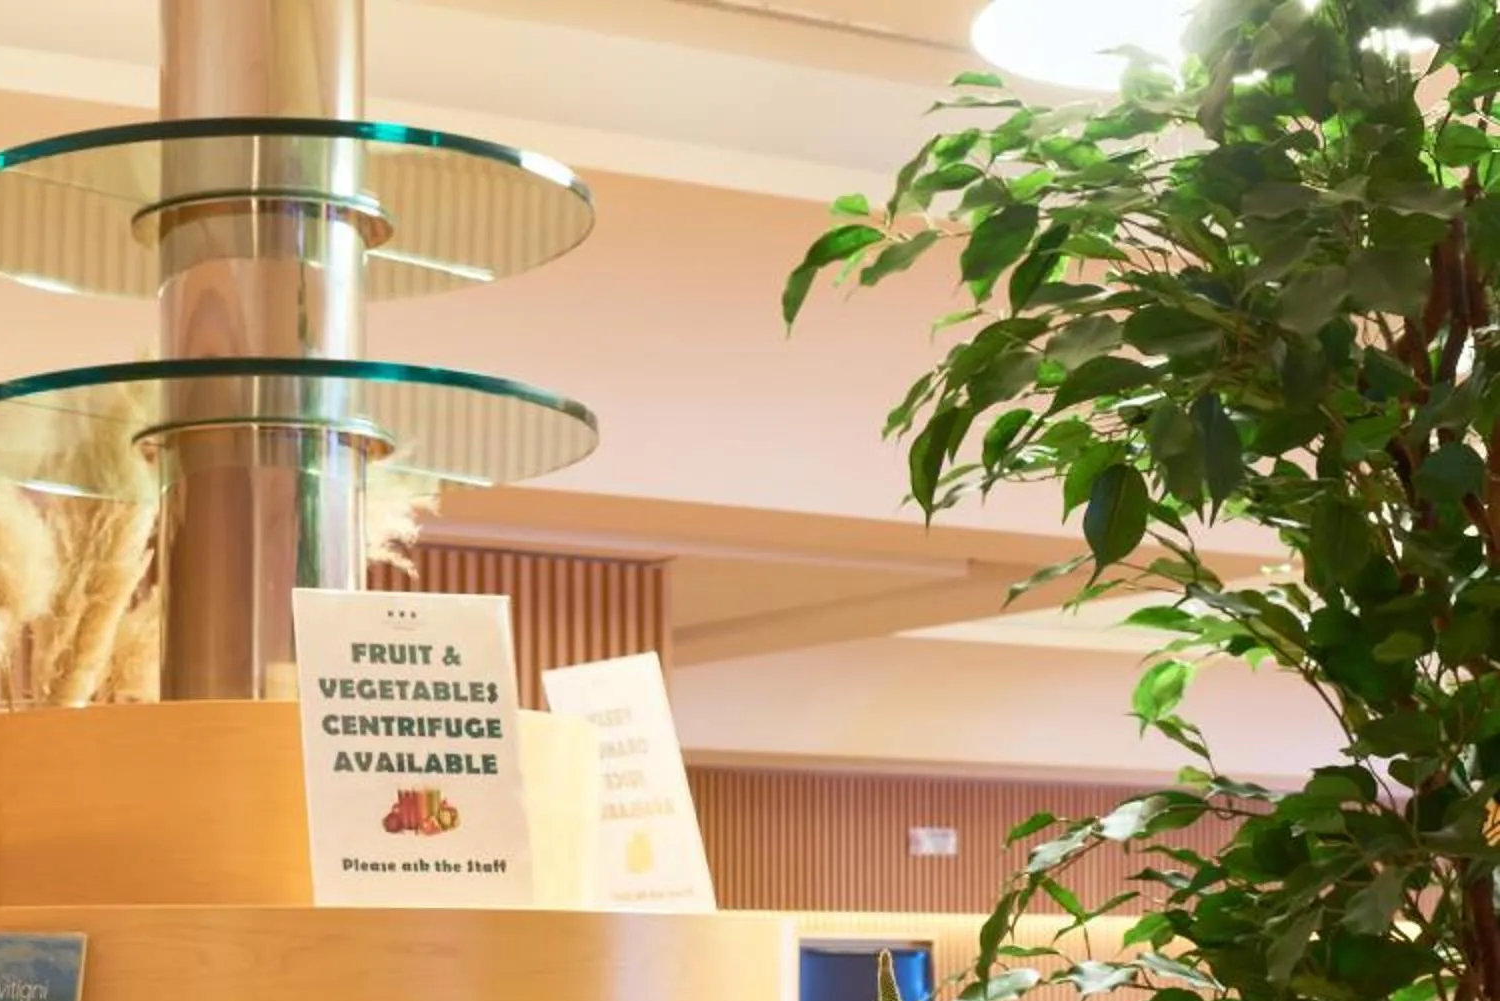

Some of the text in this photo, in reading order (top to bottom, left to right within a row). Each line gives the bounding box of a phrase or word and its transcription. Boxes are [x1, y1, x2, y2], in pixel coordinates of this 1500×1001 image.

[351, 643, 461, 666] FRUIT &
[318, 678, 499, 704] VEGETABLES
[321, 714, 503, 739] CENTRIFUGE
[333, 751, 499, 775] AVAILABLE
[342, 858, 397, 872] Please
[401, 858, 431, 873] ask
[434, 859, 462, 873] the
